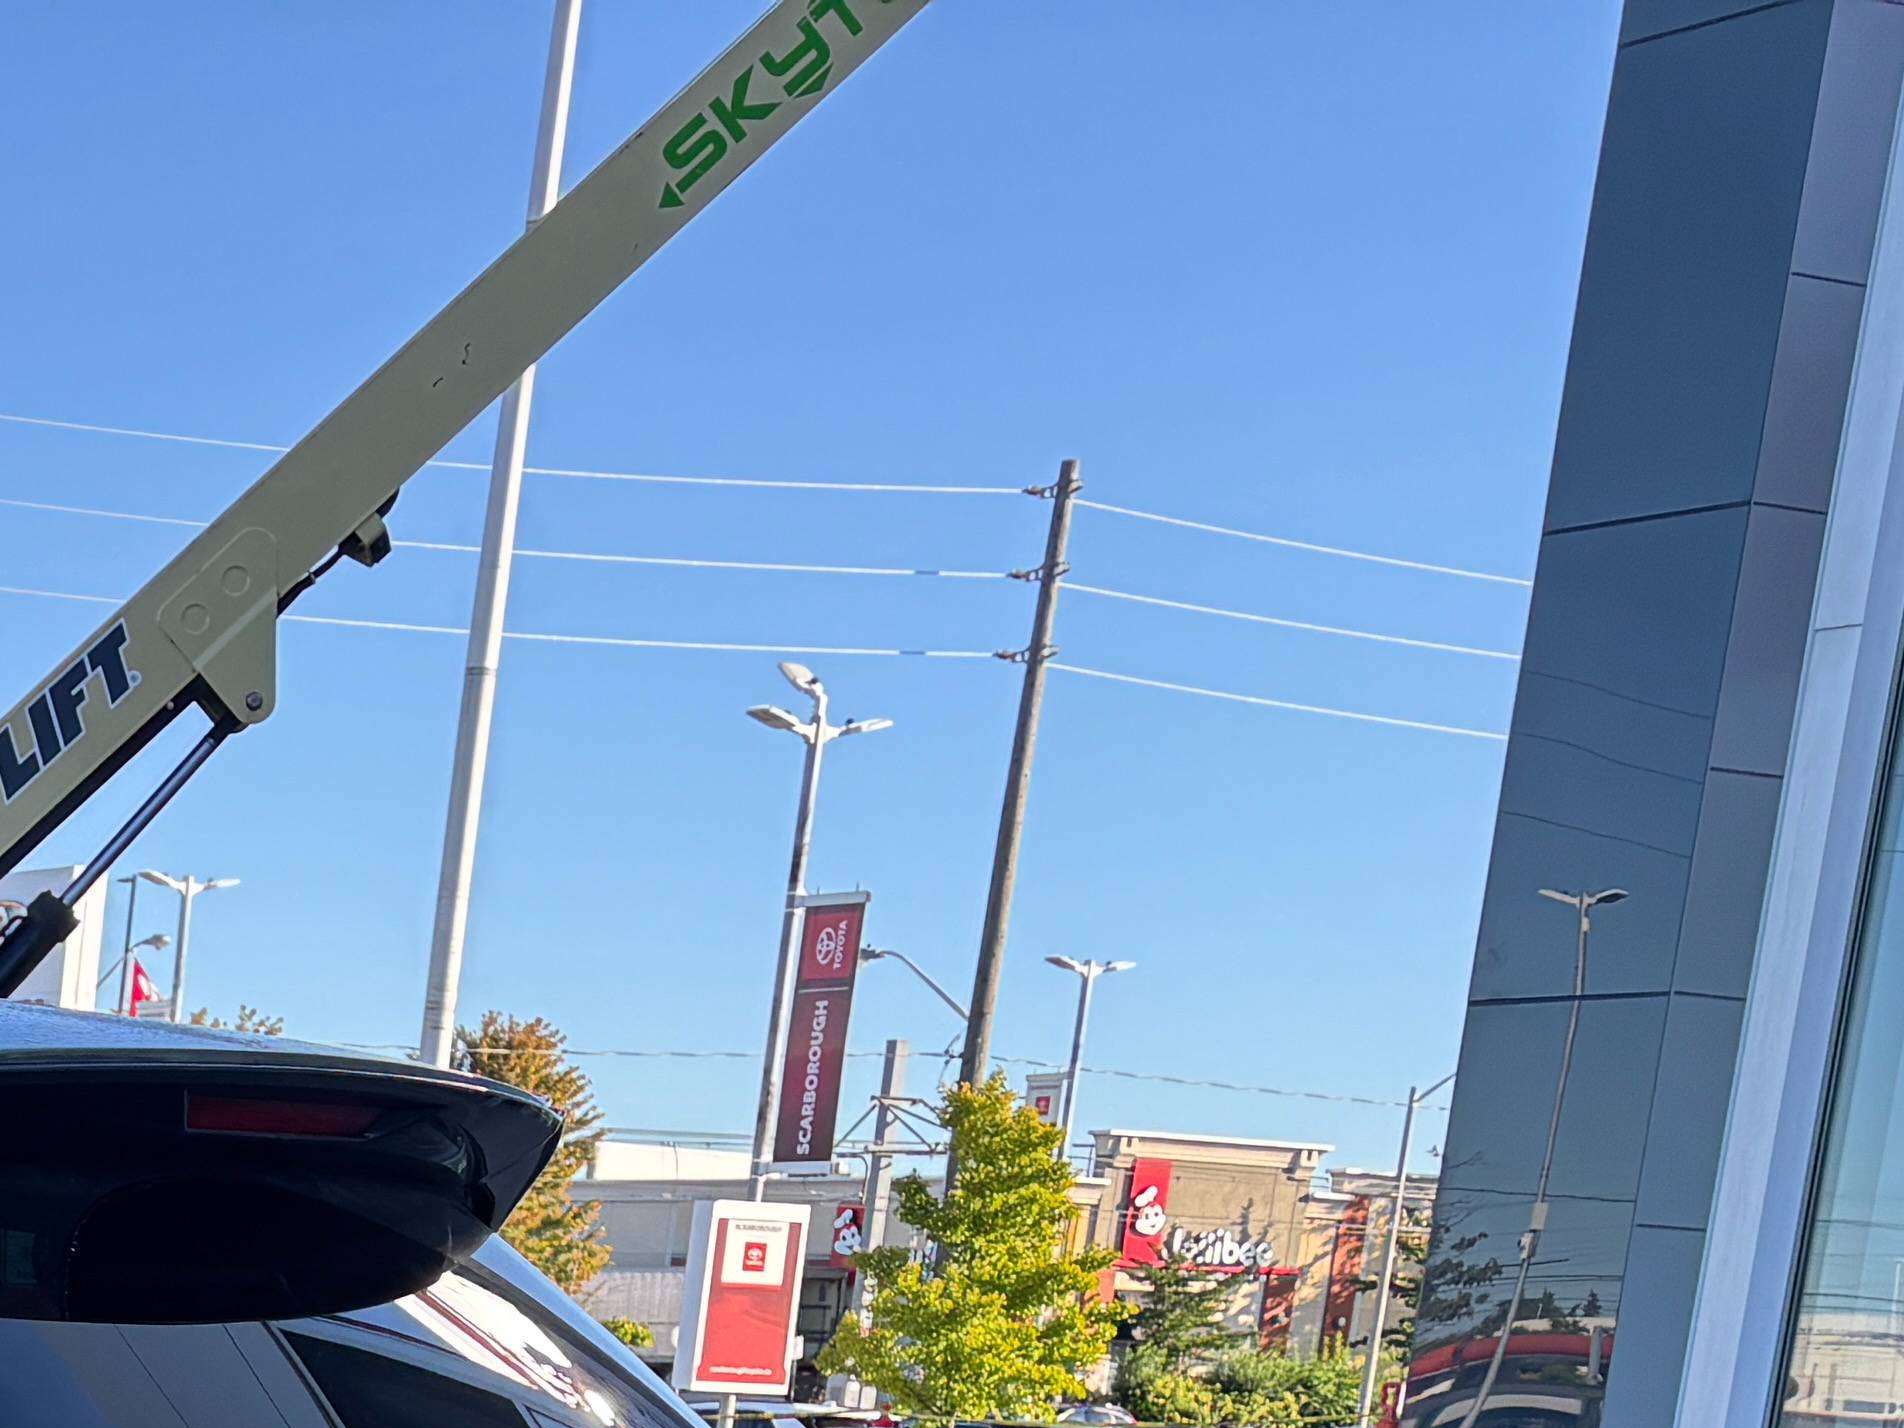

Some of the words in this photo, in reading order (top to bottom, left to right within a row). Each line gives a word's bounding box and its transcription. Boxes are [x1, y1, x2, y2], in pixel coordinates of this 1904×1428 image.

[658, 0, 895, 208] SKYT
[833, 920, 848, 969] TOYOTA
[796, 1000, 829, 1155] SCARBOROUGH
